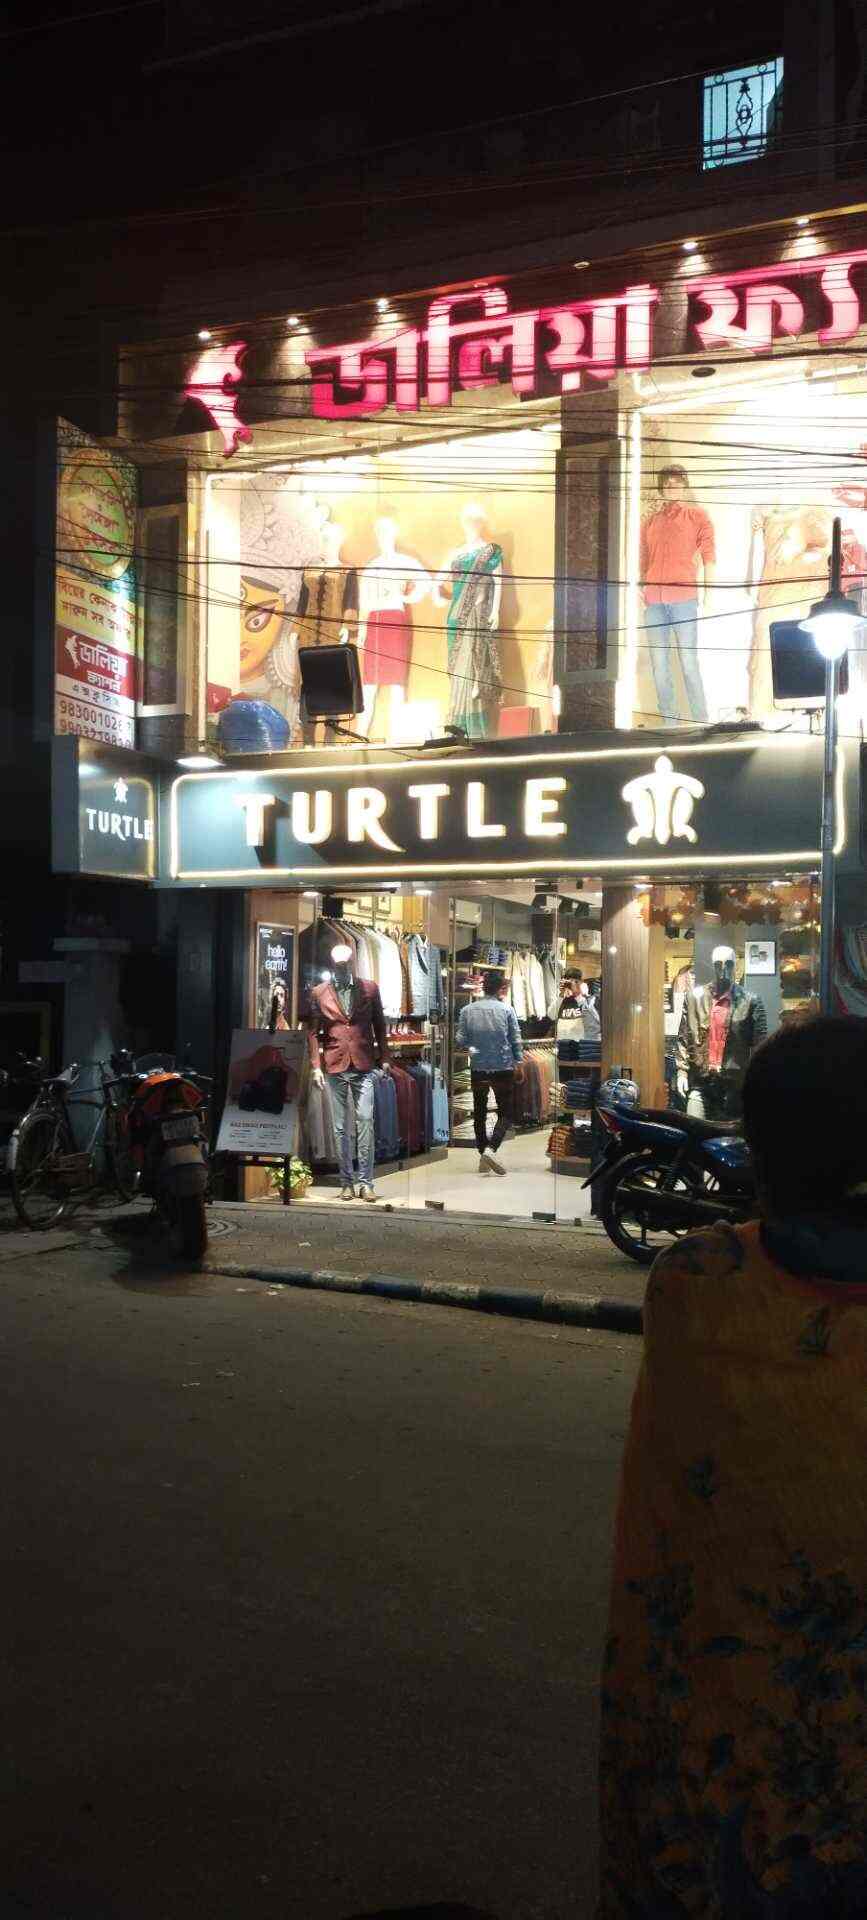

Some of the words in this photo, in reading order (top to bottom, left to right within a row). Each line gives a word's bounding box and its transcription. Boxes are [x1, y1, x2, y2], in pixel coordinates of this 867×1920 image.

[303, 284, 660, 420] ডালিয়া
[79, 641, 129, 682] ডালিয়া
[85, 807, 154, 841] TURTLE
[231, 777, 569, 853] TURTLE
[267, 943, 286, 958] hello
